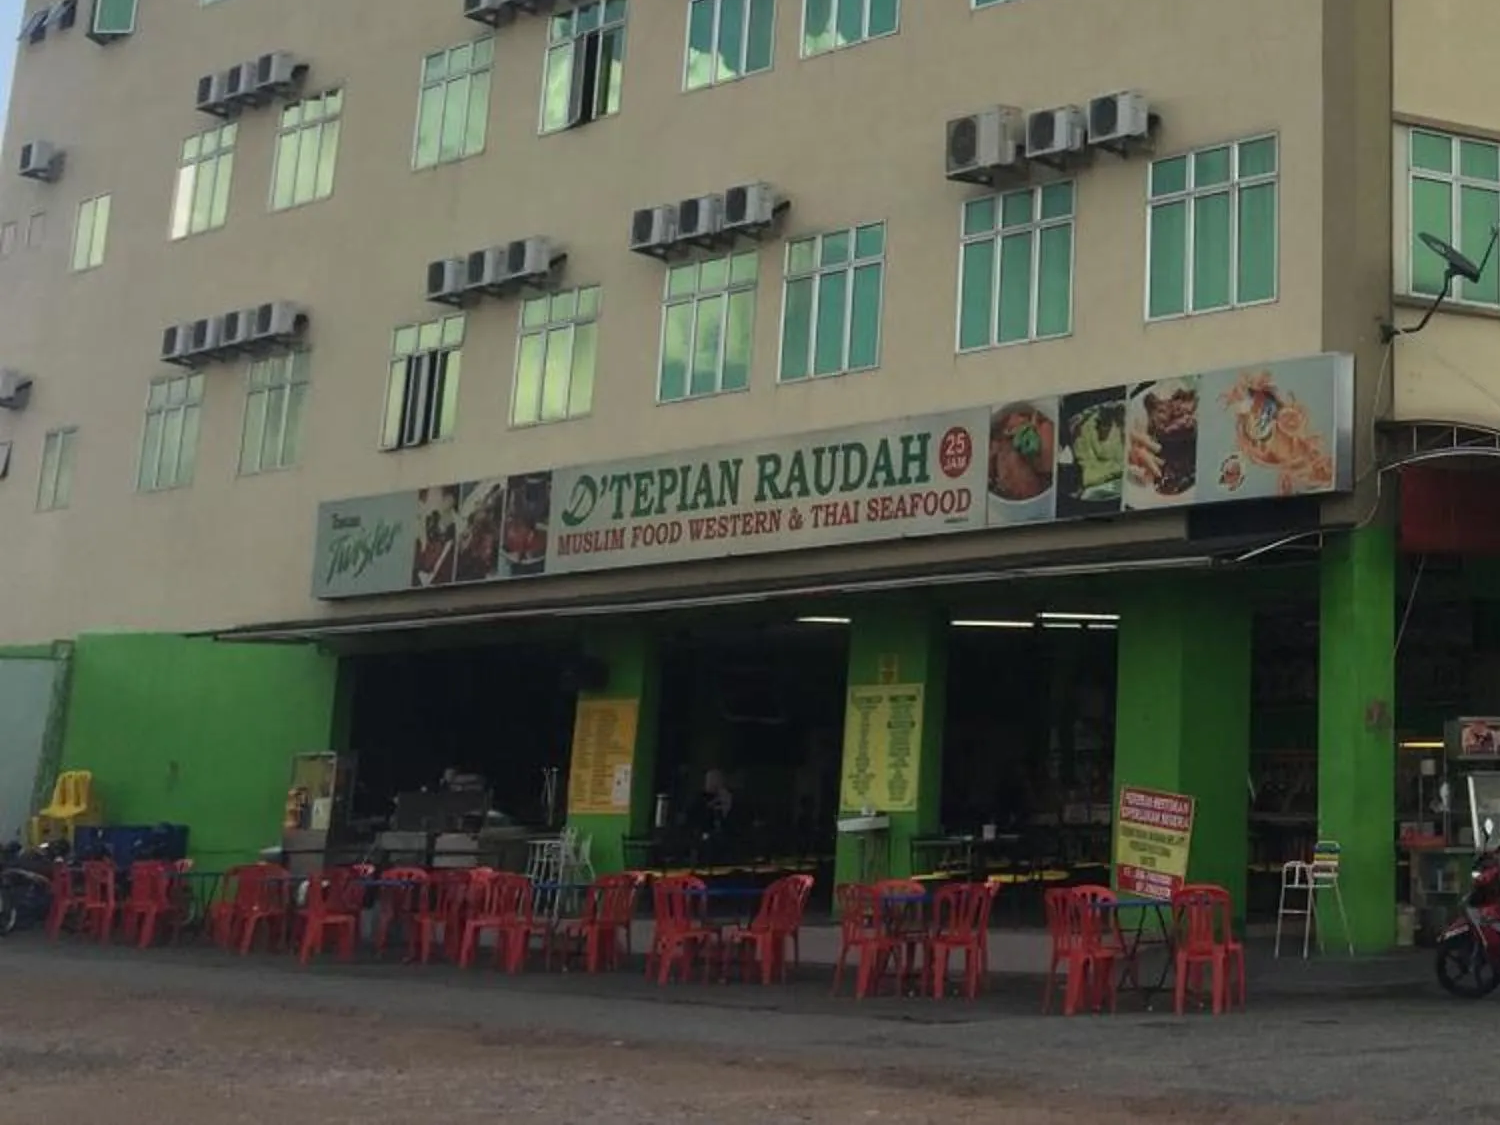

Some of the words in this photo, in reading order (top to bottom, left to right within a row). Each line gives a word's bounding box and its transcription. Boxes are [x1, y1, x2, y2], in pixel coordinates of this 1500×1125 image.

[944, 455, 969, 473] JAM
[946, 432, 966, 455] 25
[754, 432, 931, 502] RAUDAH
[557, 528, 624, 556] MUSLIM
[631, 520, 682, 548] FOOD
[688, 508, 782, 541] WESTERN
[789, 507, 803, 530] &
[811, 499, 860, 528] THAI
[867, 487, 972, 522] SEAFOOD
